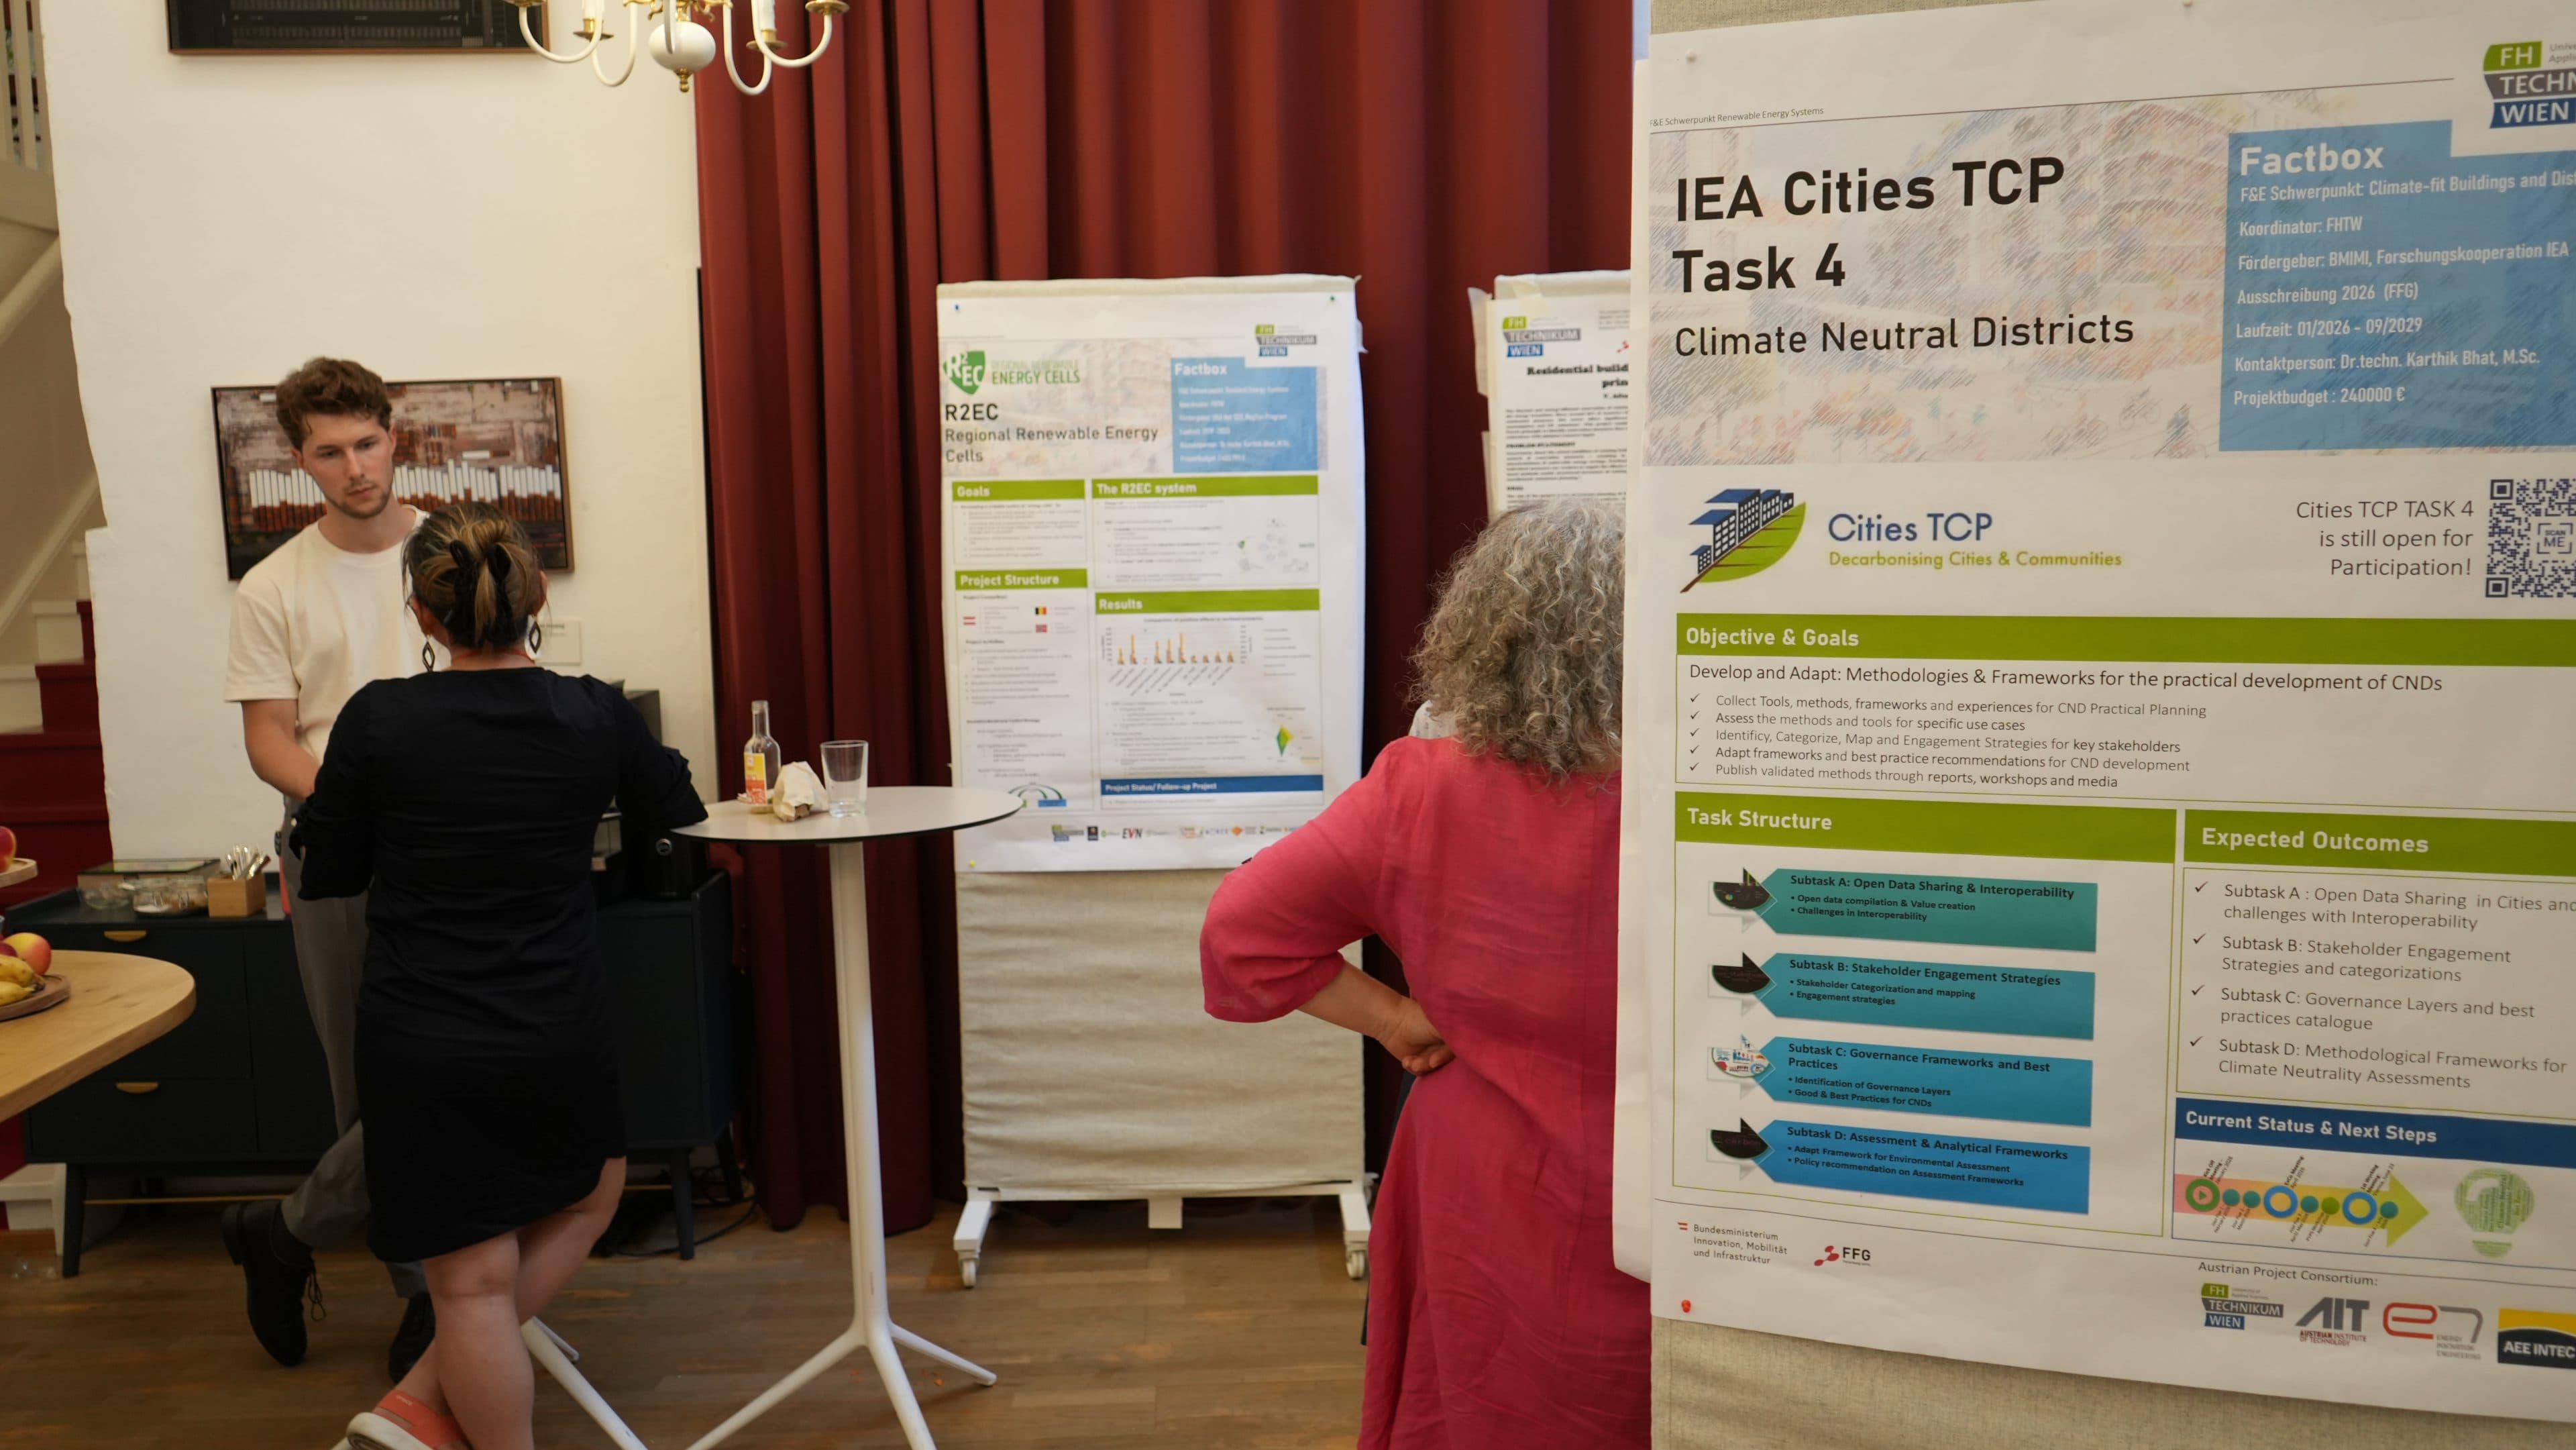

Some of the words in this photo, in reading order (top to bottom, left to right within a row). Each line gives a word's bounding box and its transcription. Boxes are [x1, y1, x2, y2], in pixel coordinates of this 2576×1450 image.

[2500, 45, 2533, 67] FH
[1665, 114, 1716, 126] Schwerpunkt
[1717, 111, 1761, 122] Renewable
[1762, 109, 1789, 119] Energy
[1790, 107, 1825, 118] Systems
[2500, 101, 2569, 125] WIEN
[2240, 142, 2383, 176] Factbox
[1677, 174, 1764, 223] IEA
[1784, 166, 1935, 217] Cities
[1951, 156, 2065, 207] TCP
[2241, 185, 2267, 203] F&E
[2369, 176, 2446, 197] Climate-fit
[2449, 174, 2516, 193] Buildings
[2520, 170, 2547, 189] and
[2239, 219, 2322, 238] Koordinator:
[2326, 215, 2363, 233] FHTW
[2238, 252, 2325, 273] Fördergeber:
[2328, 250, 2373, 268] BMIMI,
[2377, 242, 2543, 266] Forschungskooperation
[2546, 240, 2569, 258] IEA
[1672, 245, 1796, 294] Task
[1815, 242, 1846, 287] 4
[2237, 287, 2337, 305] Ausschreibung
[2341, 284, 2375, 301] 2026
[2383, 281, 2418, 301] (FFG)
[1509, 318, 1524, 329] FH
[2297, 319, 2351, 339] 01/2026
[2365, 316, 2423, 336] 09/2029
[1509, 329, 1577, 341] TECHNIKUM
[1676, 325, 1807, 357] Climate
[1822, 317, 1958, 353] Neutral
[1974, 313, 2134, 348] Districts
[1510, 345, 1542, 356] WIEN
[2235, 355, 2337, 374] Kontaktperson:
[2340, 352, 2403, 370] Dr.techn.
[2406, 350, 2459, 368] Karthik
[2462, 349, 2499, 367] Bhat,
[2503, 348, 2540, 365] M.Sc.
[991, 370, 1040, 385] ENERGY
[1044, 369, 1081, 384] CELLS
[1174, 362, 1228, 376] Factbox
[2233, 389, 2328, 409] Projektbudget
[2340, 386, 2392, 404] 240000
[2396, 386, 2406, 403] €
[945, 403, 999, 421] R2EC
[945, 427, 1011, 446] Regional
[1016, 425, 1100, 442] Renewable
[1105, 425, 1159, 443] Energy
[945, 448, 983, 464] Cells
[957, 485, 990, 498] Goals
[1097, 482, 1118, 495] The
[1121, 482, 1152, 495] R2EC
[1154, 482, 1197, 497] system
[2296, 501, 2353, 519] Cities
[2358, 500, 2398, 519] TCP
[2404, 500, 2456, 519] TASK
[2461, 499, 2475, 517] 4
[1828, 513, 1918, 542] Cities
[1926, 512, 1993, 542] TCP
[2320, 529, 2334, 548] is
[2341, 528, 2376, 548] still
[2382, 533, 2436, 552] open
[2443, 528, 2474, 548] for
[2544, 537, 2566, 548] ME
[1829, 550, 1943, 570] Decarbonising
[1948, 550, 1992, 566] Cities
[1998, 550, 2010, 566] &
[2016, 550, 2123, 567] Communities
[2331, 557, 2471, 580] Participation!
[960, 574, 1001, 588] Project
[1004, 573, 1060, 586] Structure
[1099, 598, 1143, 611] Results
[1686, 627, 1776, 650] Objective
[1782, 627, 1796, 646] &
[1803, 627, 1859, 647] Goals
[1690, 663, 1752, 682] Develop
[1756, 665, 1785, 680] and
[1789, 665, 1841, 684] Adapt:
[1847, 666, 1969, 687] Methodologies
[1973, 668, 1986, 684] &
[1992, 669, 2095, 686] Frameworks
[2099, 670, 2125, 686] for
[2129, 670, 2158, 687] the
[2163, 672, 2237, 690] practical
[2243, 672, 2363, 692] development
[2367, 673, 2388, 690] of
[2392, 674, 2443, 691] CNDs
[1686, 807, 1733, 826] Task
[1738, 809, 1832, 831] Structure
[1122, 827, 1143, 839] EVN
[2202, 827, 2304, 851] Expected
[2312, 830, 2429, 853] Outcomes
[1790, 874, 1835, 887] Subtask
[1838, 876, 1850, 888] A:
[1854, 877, 1885, 890] Open
[1888, 879, 1915, 890] Data
[1919, 880, 1964, 895] Sharing
[1966, 882, 1976, 894] &
[1980, 883, 2074, 900] Interoperability
[2222, 935, 2284, 951] Subtask
[2288, 938, 2302, 953] B:
[2307, 939, 2403, 957] Stakeholder
[2408, 943, 2511, 964] Engagement
[2186, 1110, 2252, 1129] Current
[2257, 1115, 2314, 1134] Status
[2320, 1120, 2332, 1136] &
[2339, 1121, 2380, 1139] Next
[2385, 1125, 2437, 1146] Steps
[1693, 1223, 1778, 1241] Bundesministerium
[1694, 1235, 1743, 1252] Innovation,
[1746, 1241, 1788, 1255] Mobilität
[1842, 1247, 1871, 1261] FFG
[1693, 1249, 1710, 1258] und
[1713, 1249, 1771, 1265] Infrastruktur
[2198, 1261, 2249, 1276] Austrian
[2253, 1265, 2297, 1281] Project
[2300, 1270, 2378, 1287] Consortium:
[2210, 1285, 2225, 1296] FH
[2208, 1299, 2281, 1316] TECHNIKUM
[2295, 1296, 2370, 1332] AIT
[2209, 1314, 2241, 1328] WIEN
[2300, 1329, 2332, 1339] AUSTRIAN
[2504, 1340, 2532, 1355] AEE
[2533, 1343, 2576, 1359] INTEC
